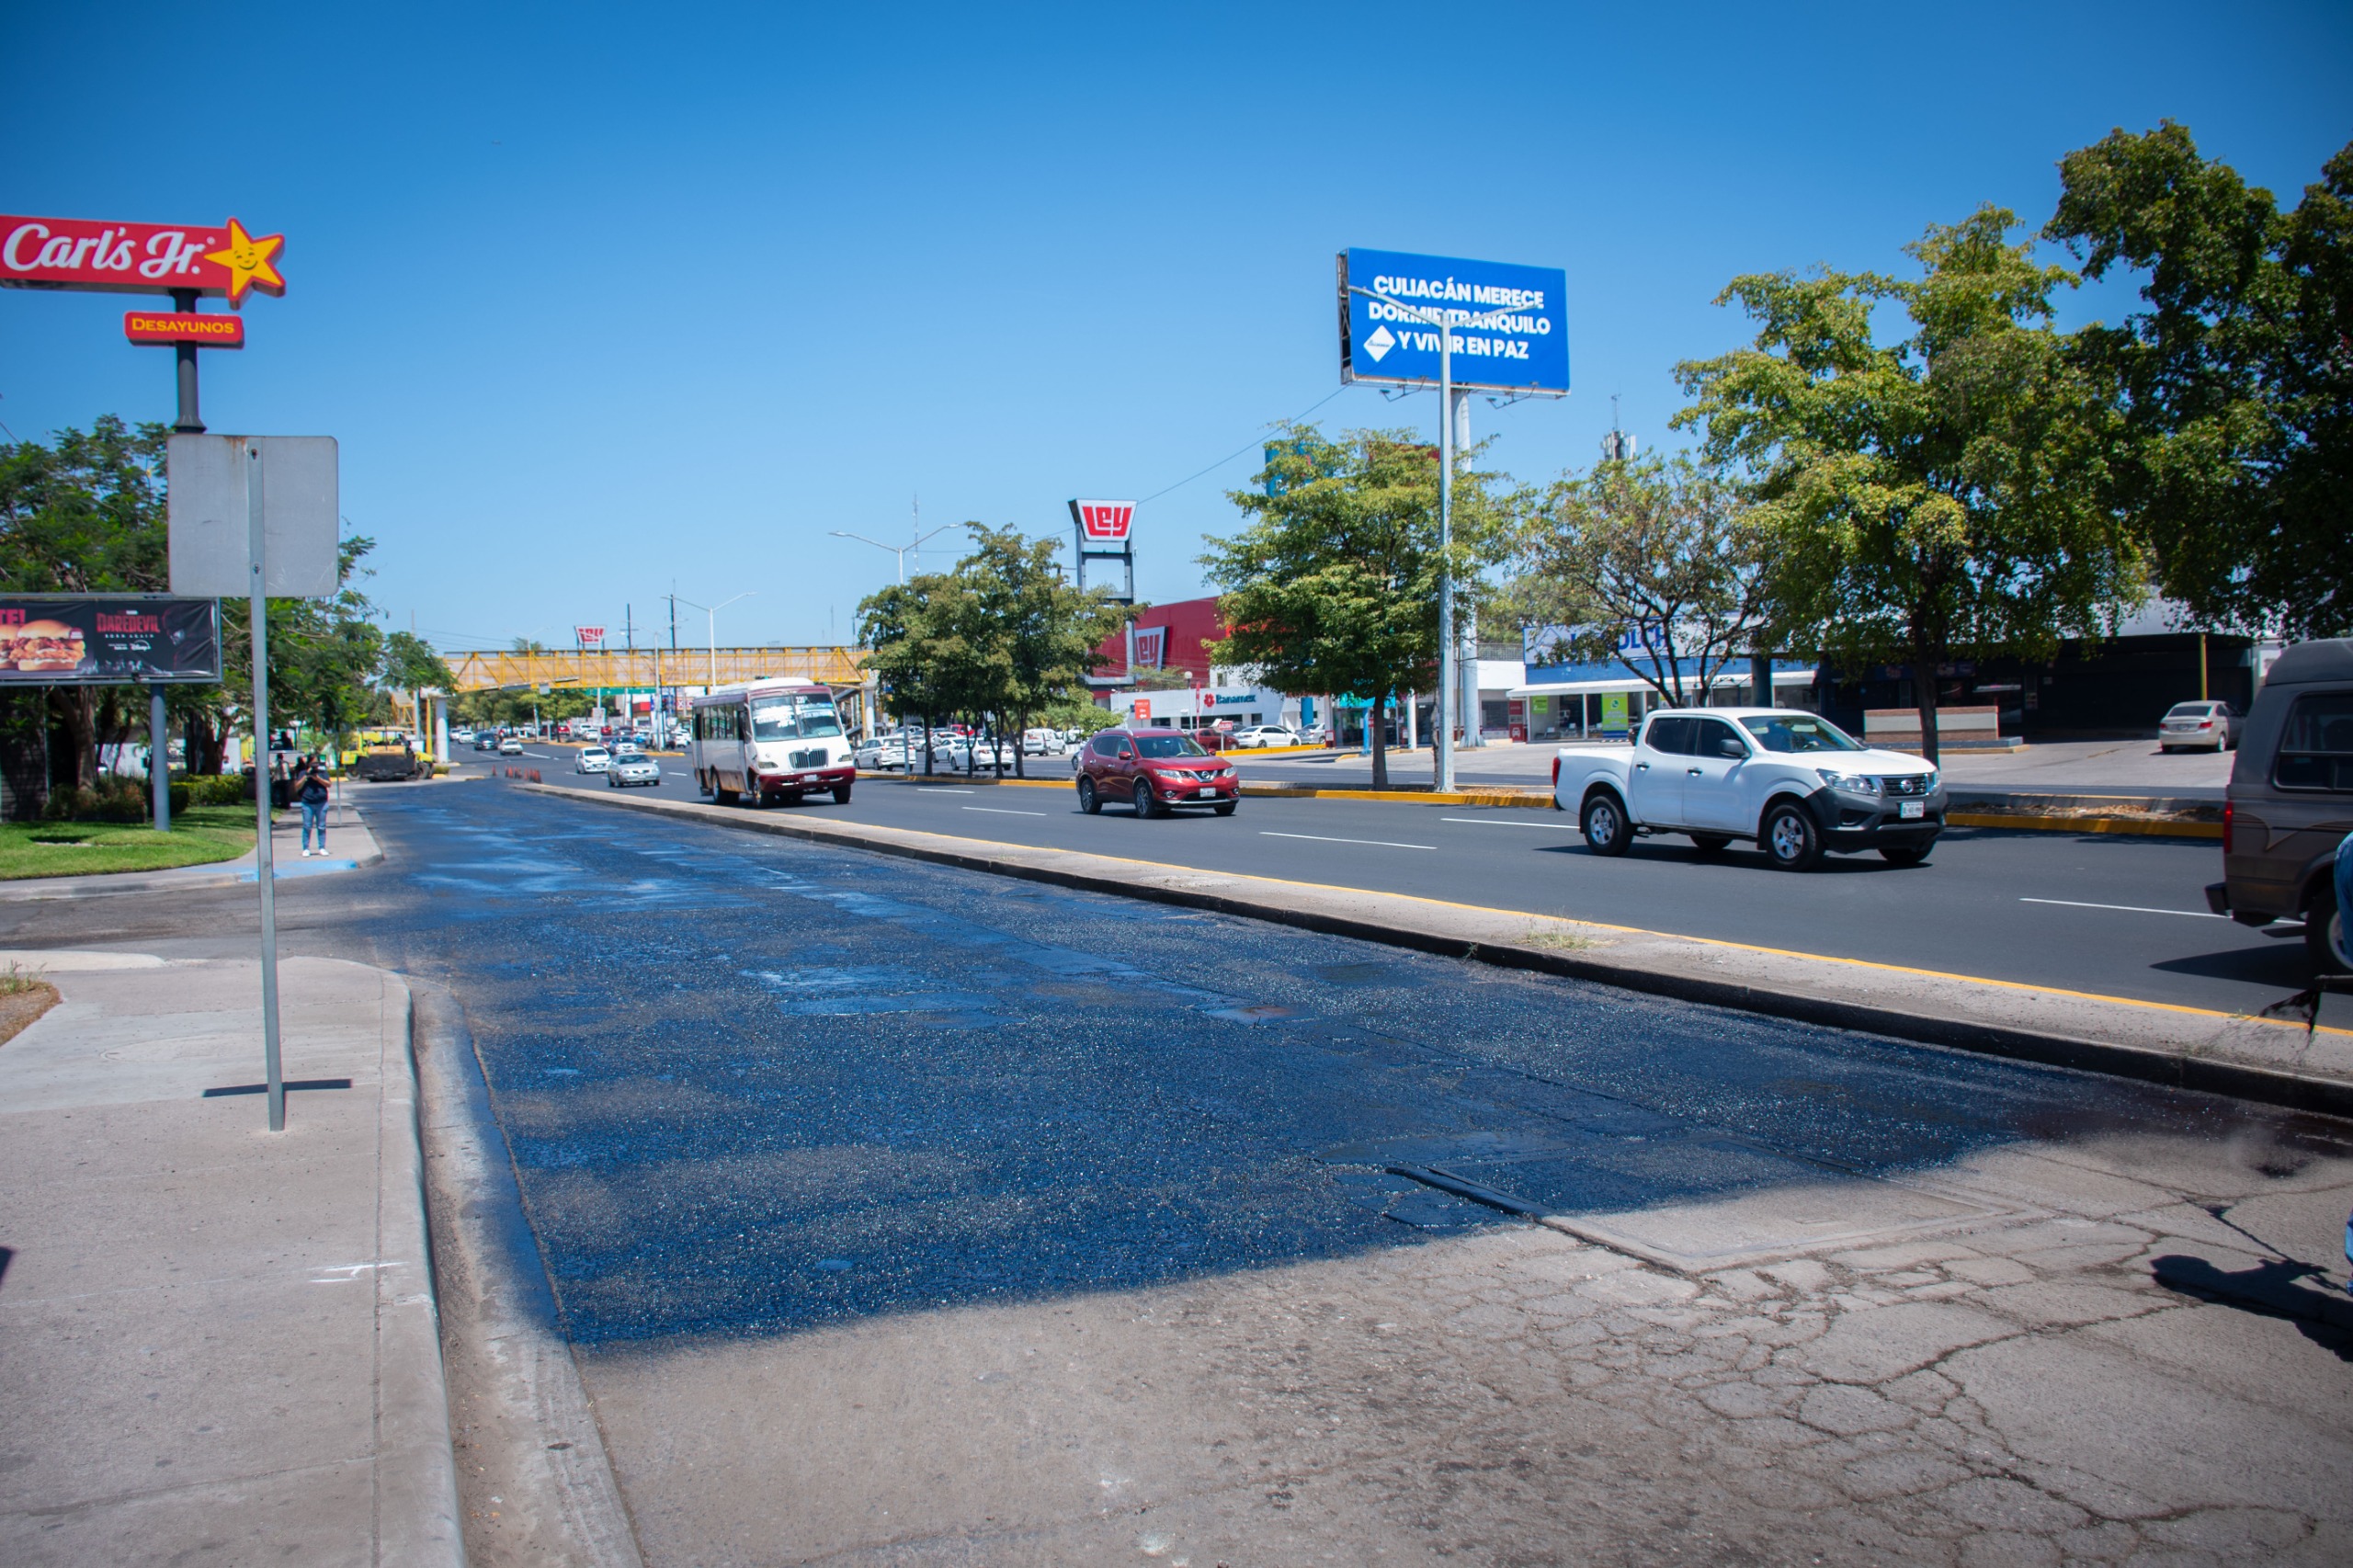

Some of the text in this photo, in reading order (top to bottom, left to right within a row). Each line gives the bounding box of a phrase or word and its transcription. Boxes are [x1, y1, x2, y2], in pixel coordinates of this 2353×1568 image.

[3, 223, 136, 271] Carl's
[1373, 276, 1544, 309] CULIACÁN MERECE
[131, 318, 234, 334] DESAYUNOS
[1447, 308, 1551, 335] TRANQUILO
[1397, 331, 1412, 349] Y
[1467, 336, 1492, 357] EN
[1494, 339, 1529, 359] PAZ
[96, 612, 160, 632] DAREDEVIL
[1216, 694, 1256, 705] Banamex
